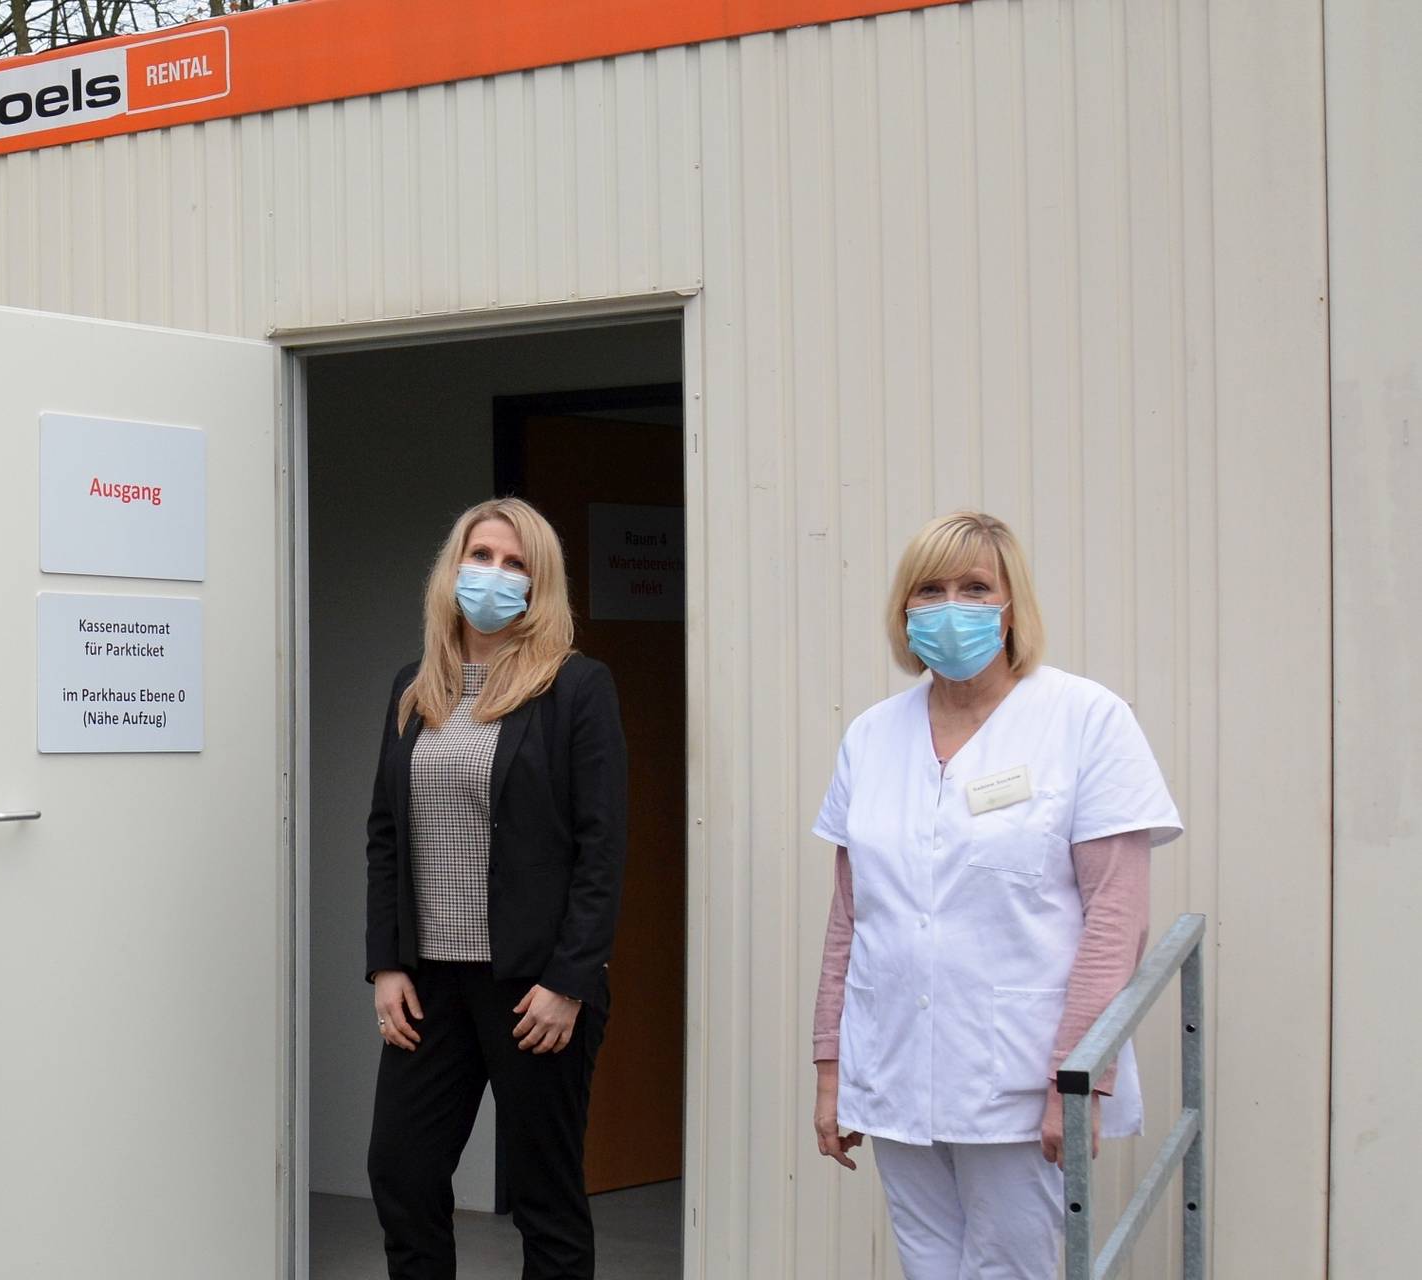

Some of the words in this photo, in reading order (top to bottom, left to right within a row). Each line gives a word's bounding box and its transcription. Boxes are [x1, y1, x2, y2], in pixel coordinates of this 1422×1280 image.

[146, 55, 213, 87] RENTAL
[89, 477, 162, 506] Ausgang
[625, 531, 658, 545] Raum
[79, 619, 170, 635] Kassenautomat
[85, 642, 102, 656] für
[106, 643, 164, 657] Parkticket
[62, 688, 78, 702] im
[82, 688, 136, 702] Parkhaus
[140, 689, 175, 703] Ebene
[178, 689, 185, 703] 0
[83, 711, 119, 728] (Nähe
[123, 711, 167, 728] Aufzug)
